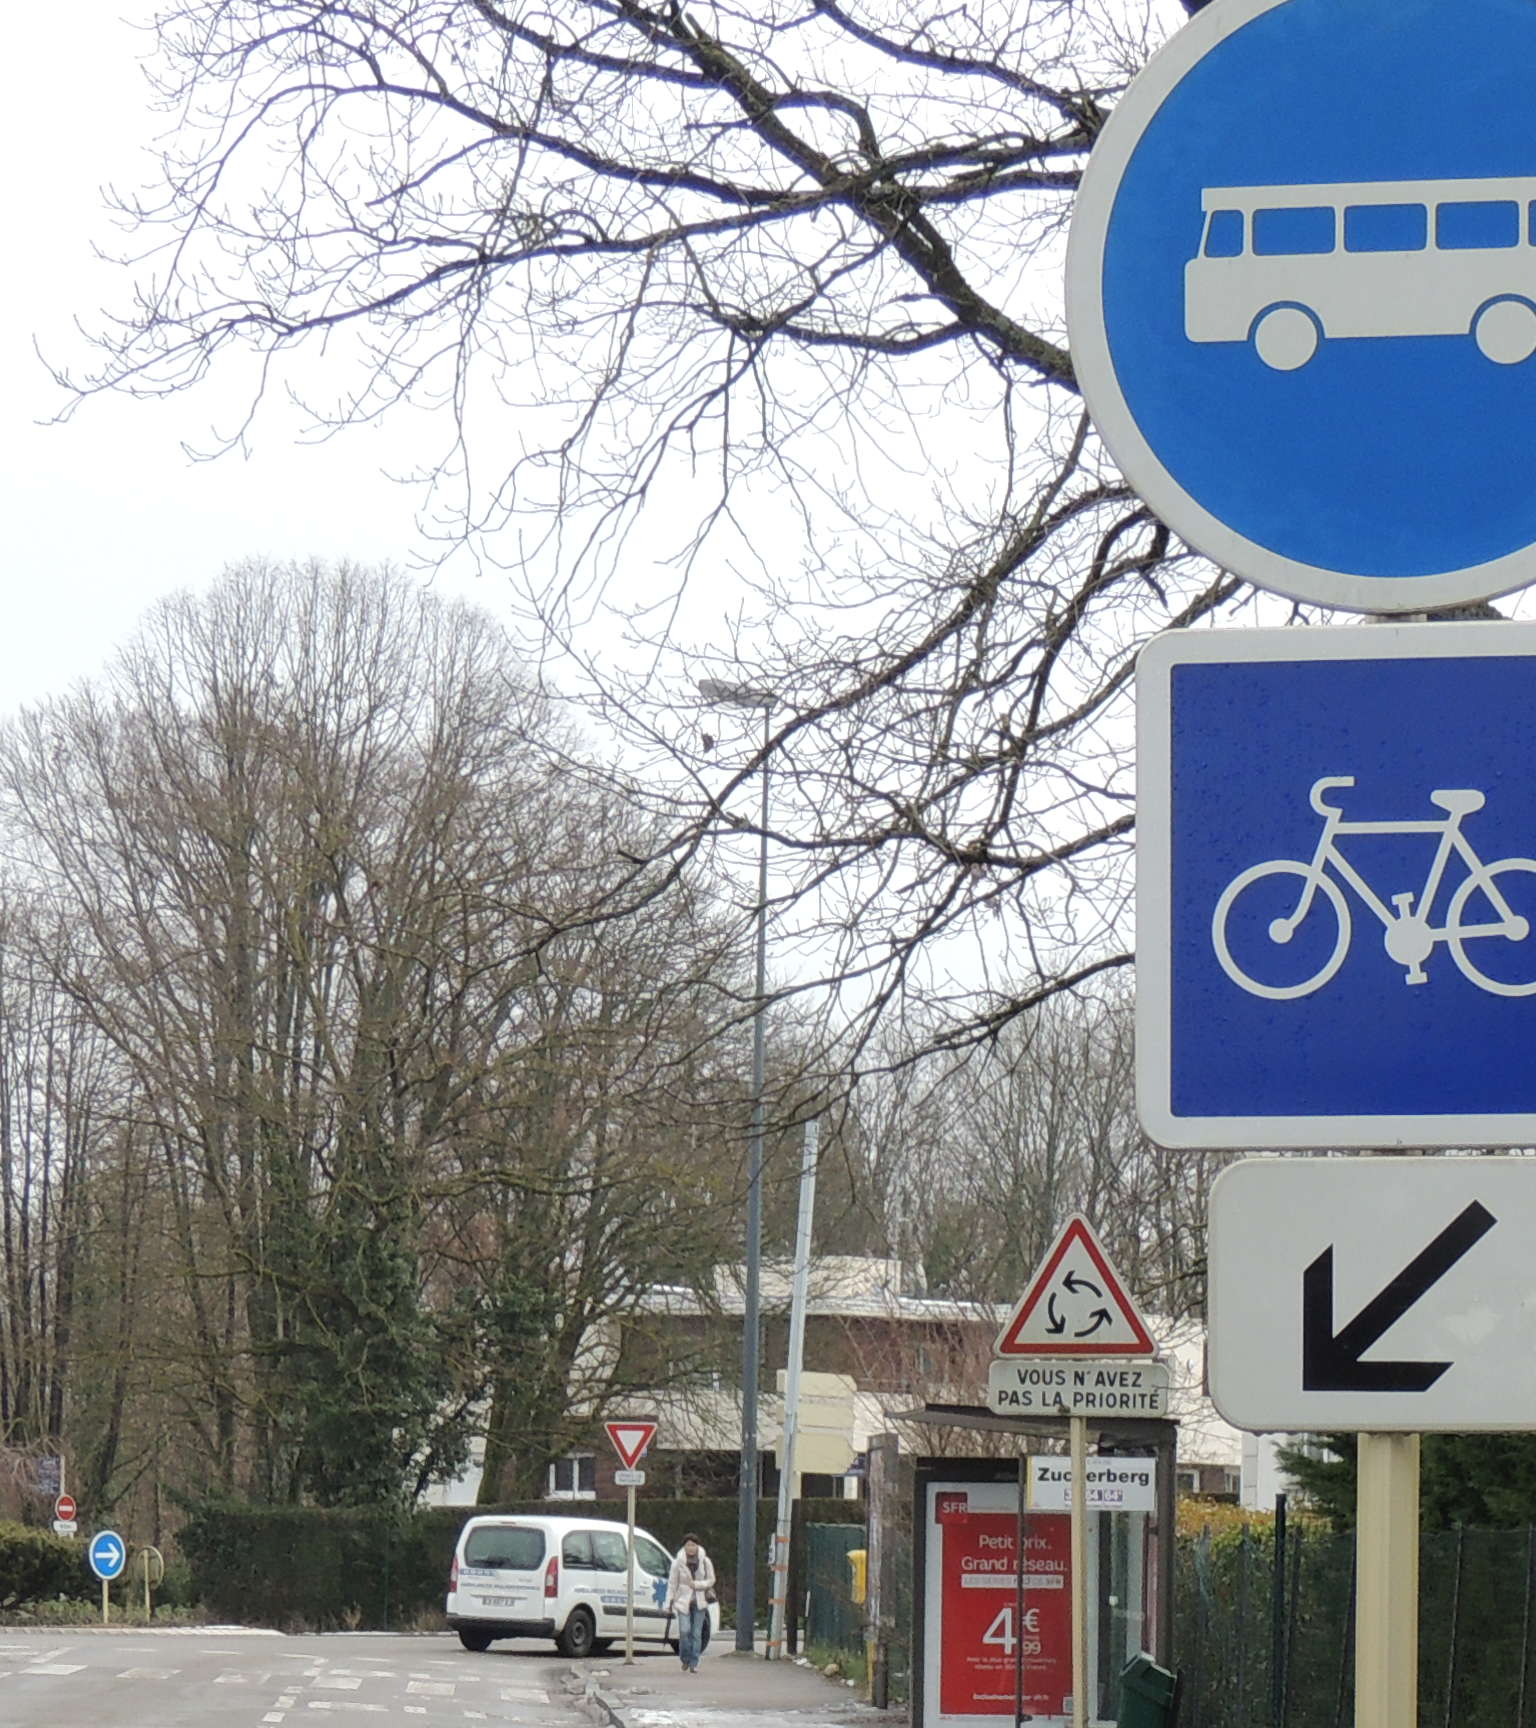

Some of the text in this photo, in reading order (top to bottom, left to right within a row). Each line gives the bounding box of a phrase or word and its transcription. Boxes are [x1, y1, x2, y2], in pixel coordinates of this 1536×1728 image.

[1017, 1369, 1066, 1386] VOUS
[997, 1389, 1160, 1410] PAS LA PRIORITÉ
[1037, 1467, 1150, 1487] Zucerberg
[942, 1501, 967, 1513] SFR
[978, 1534, 1014, 1549] Petit
[960, 1556, 1008, 1571] Grand
